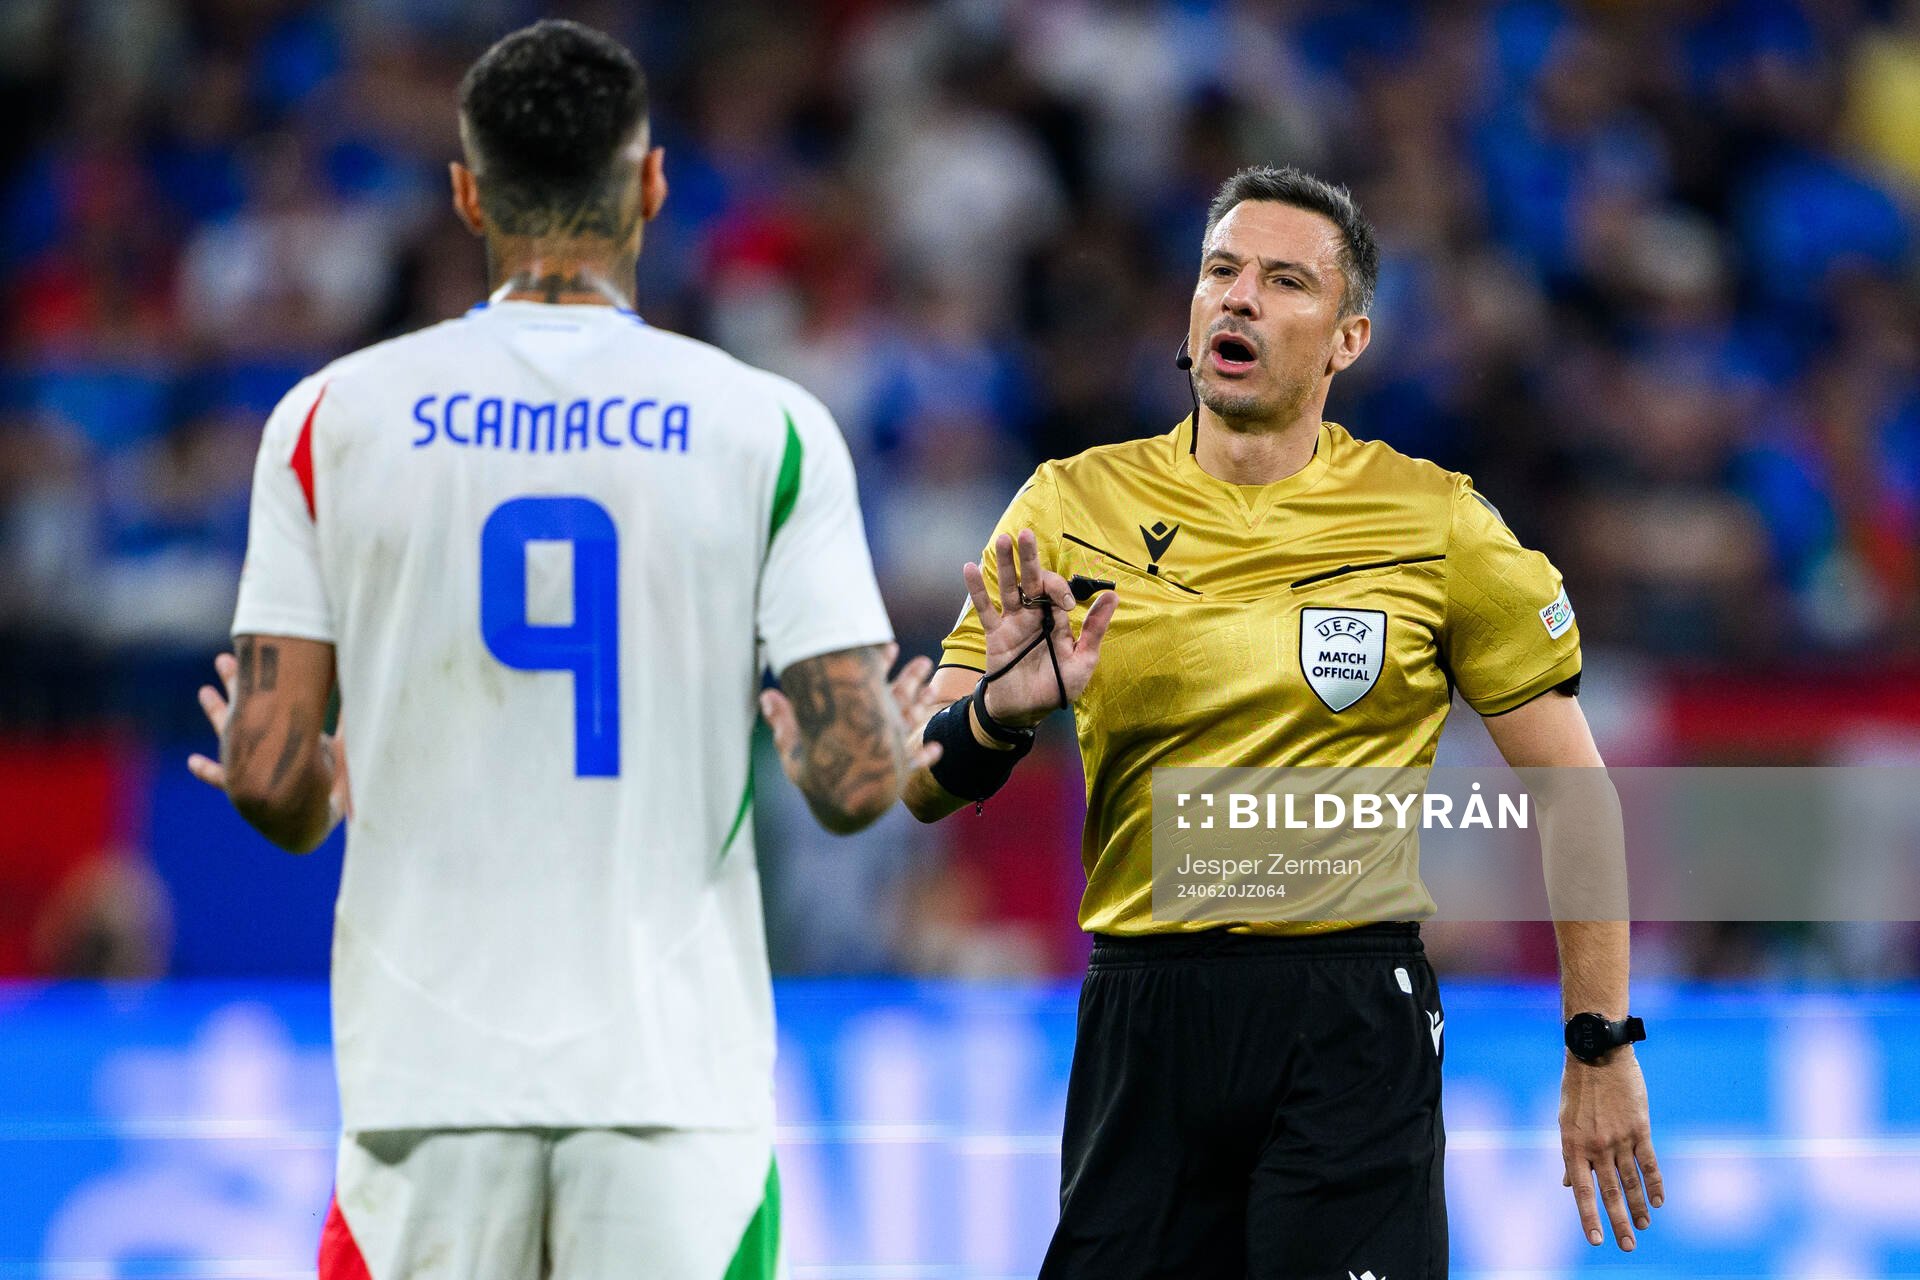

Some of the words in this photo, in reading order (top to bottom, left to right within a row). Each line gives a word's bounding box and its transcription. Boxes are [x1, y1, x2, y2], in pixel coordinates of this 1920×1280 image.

[413, 394, 690, 453] SCAMACCA
[481, 496, 620, 778] 9
[1317, 620, 1367, 641] UEFA
[1318, 651, 1367, 665] MATCH
[1312, 666, 1370, 681] OFFICIAL
